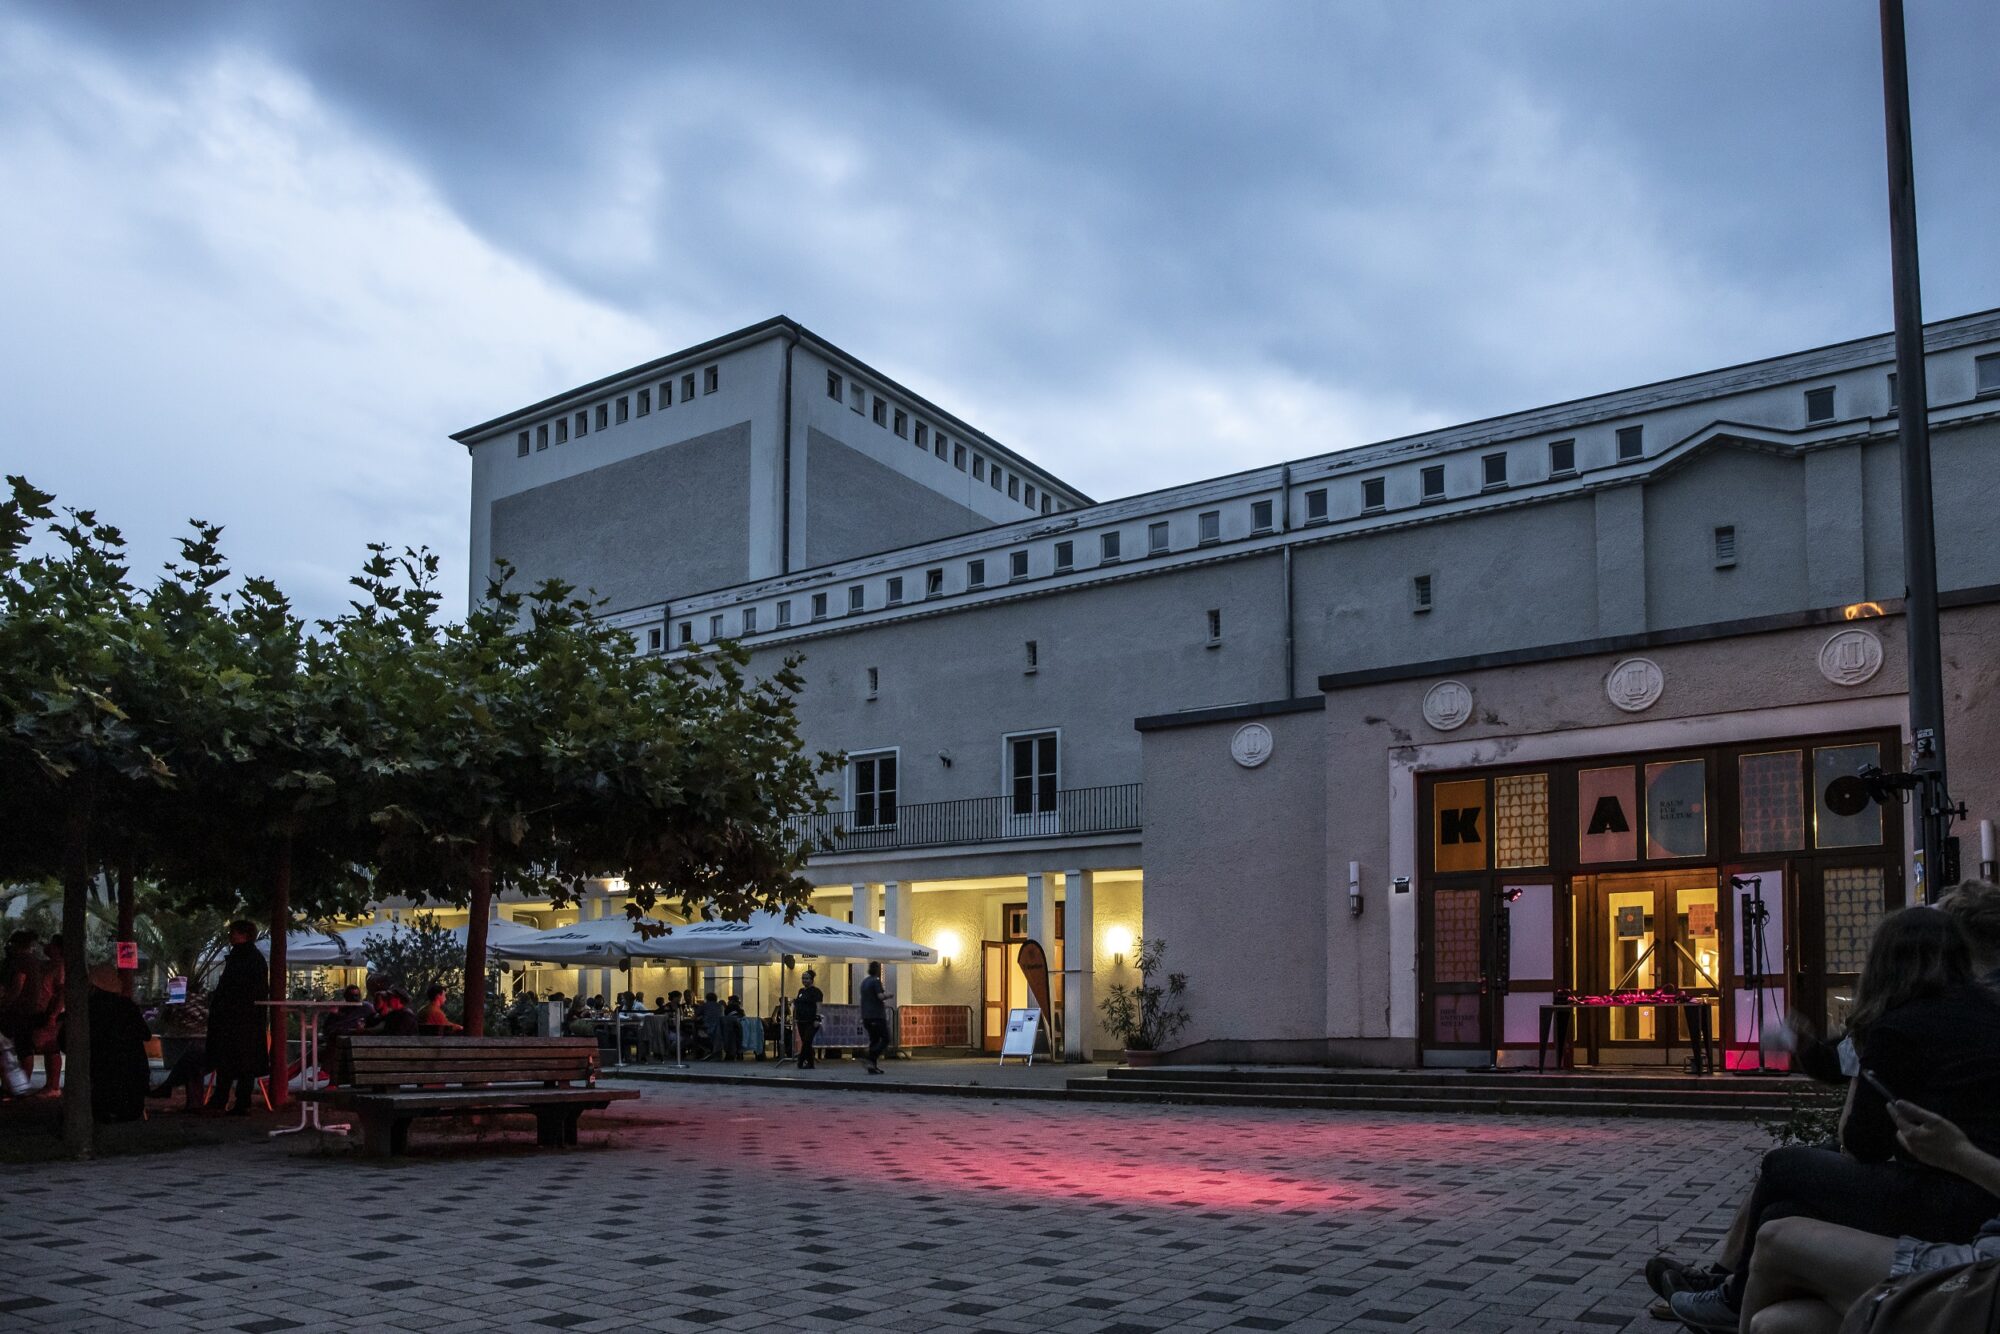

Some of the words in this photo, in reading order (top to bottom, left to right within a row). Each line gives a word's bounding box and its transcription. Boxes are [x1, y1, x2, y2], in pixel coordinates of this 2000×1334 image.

[1440, 807, 1482, 845] K
[1587, 796, 1630, 835] A
[800, 926, 873, 940] LAVAZZA
